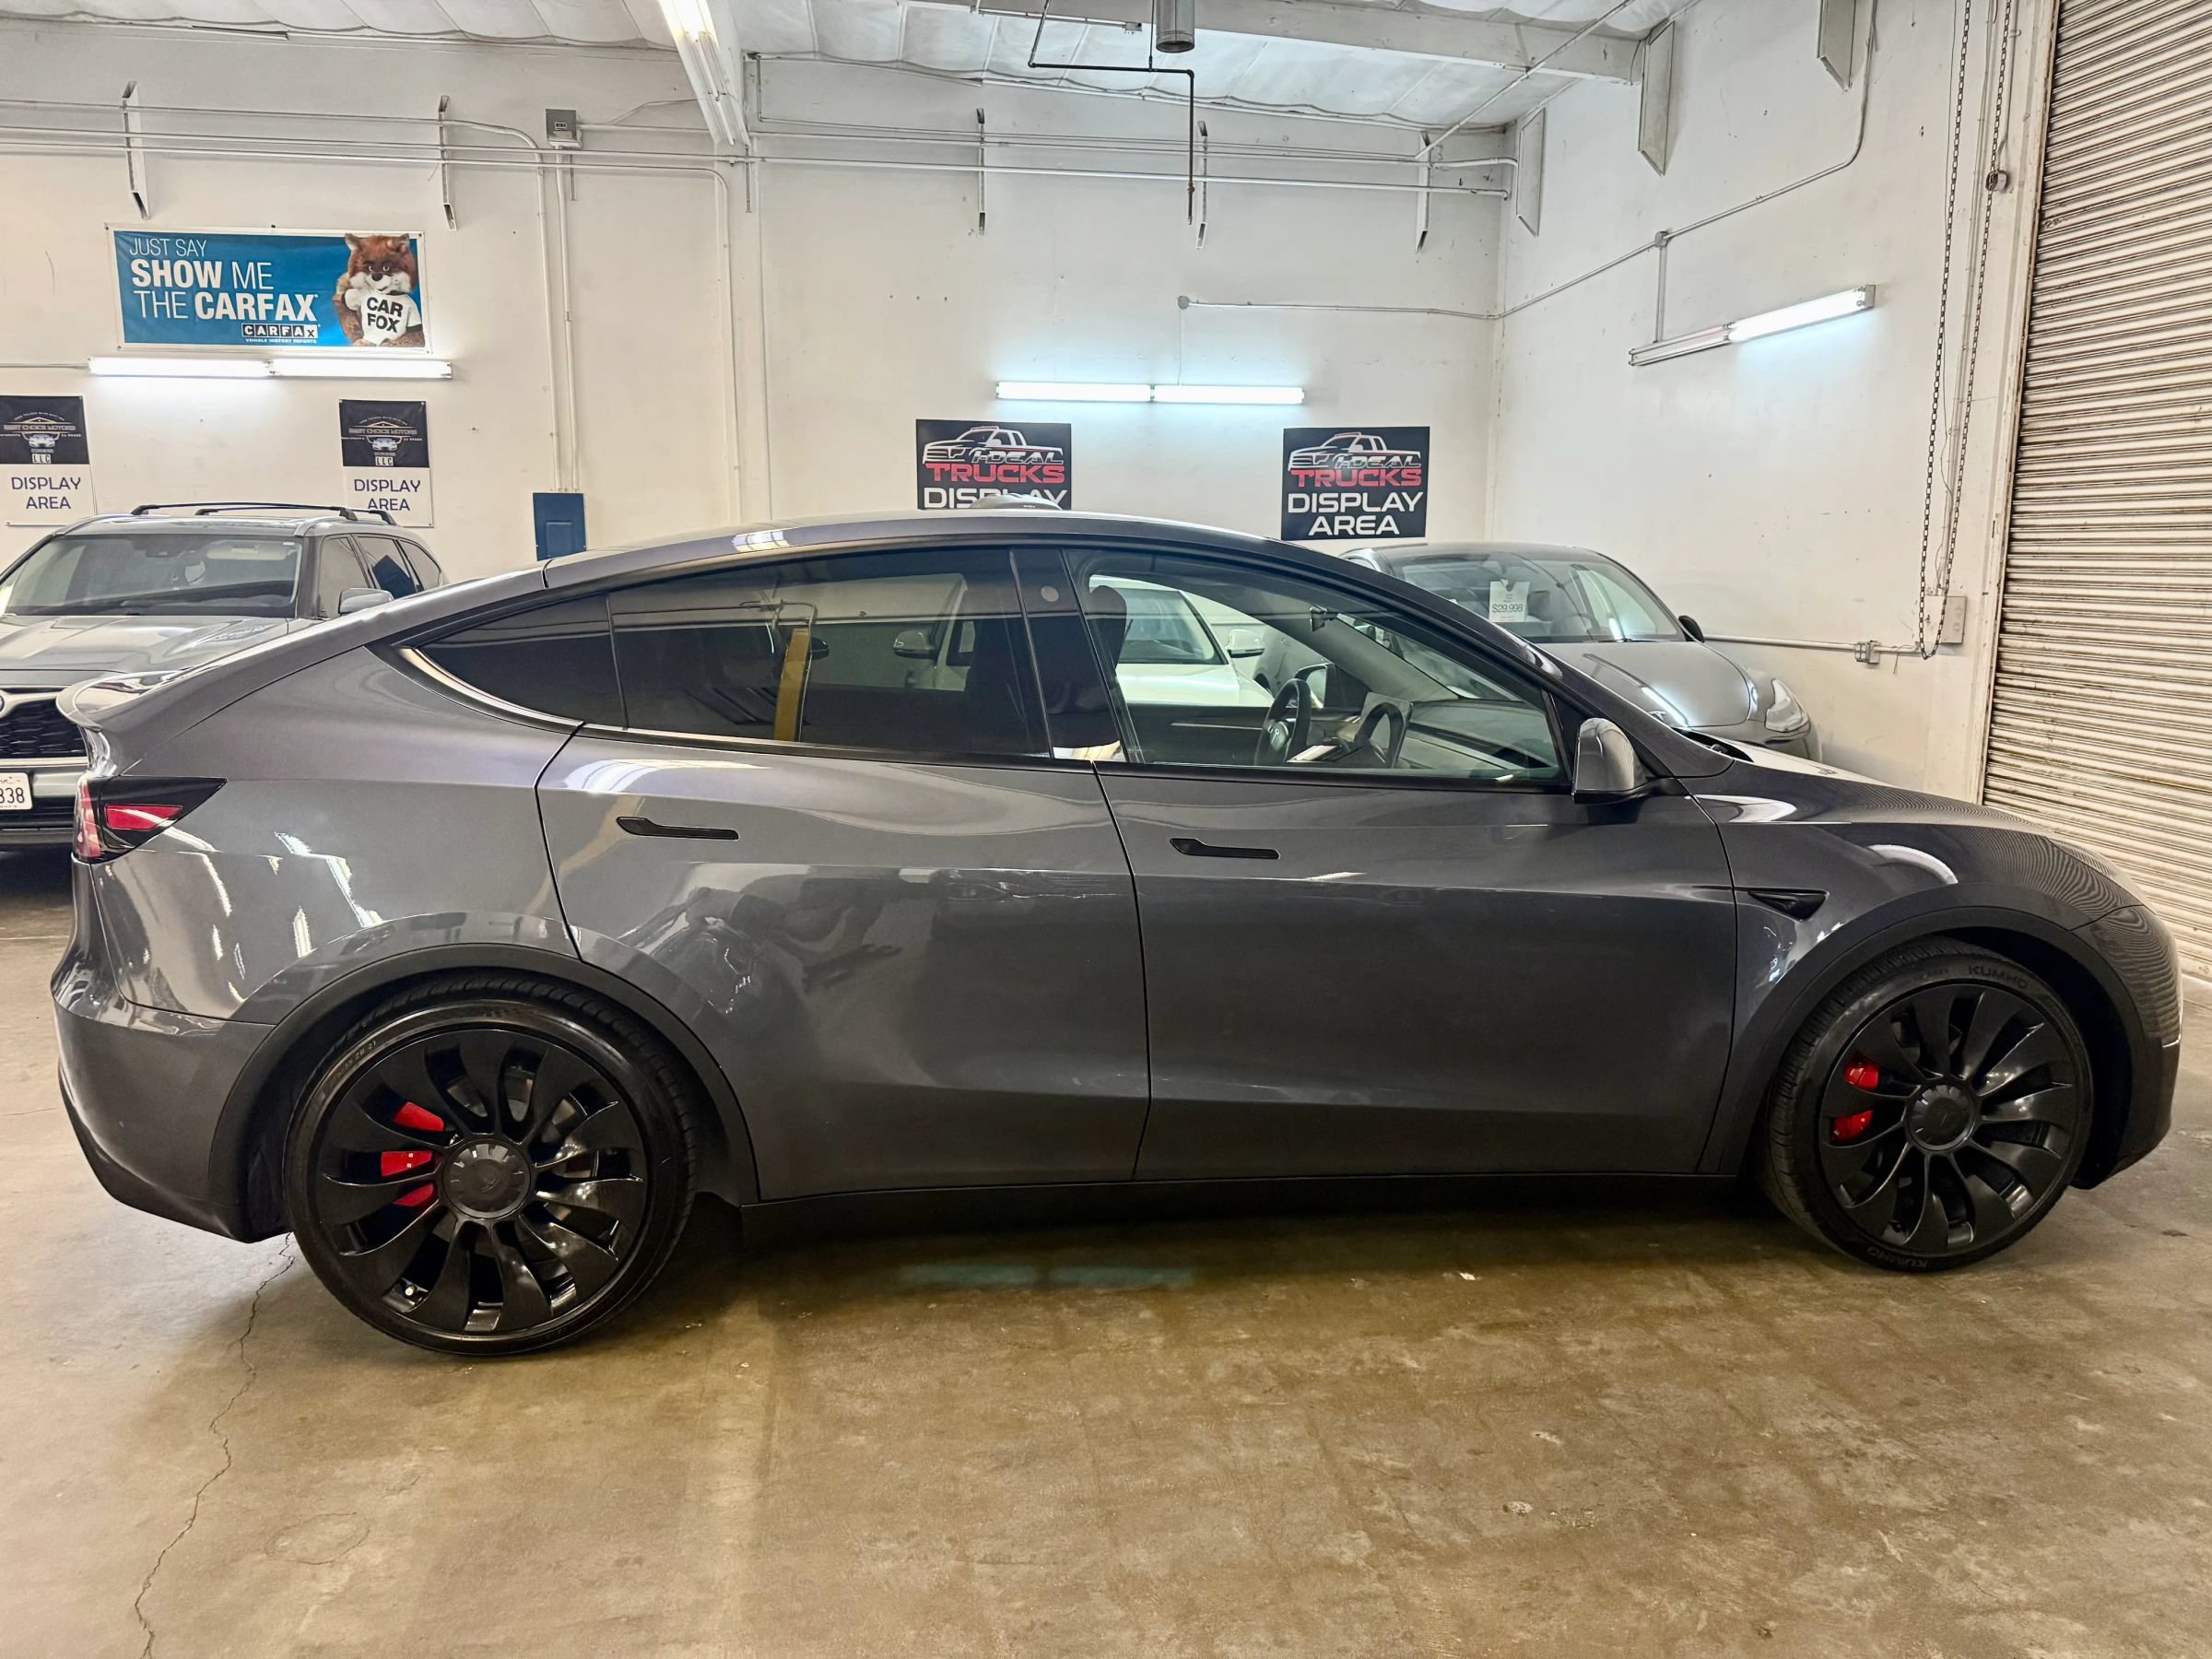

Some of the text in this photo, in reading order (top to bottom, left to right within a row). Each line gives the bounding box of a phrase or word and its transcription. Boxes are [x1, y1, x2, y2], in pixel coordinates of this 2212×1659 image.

[129, 238, 207, 257] JUST SAY
[131, 258, 274, 289] SHOW ME
[133, 290, 317, 322] THE CARFAX
[367, 296, 404, 318] CAR
[242, 324, 318, 338] CARFAX
[367, 312, 400, 333] FOX
[33, 454, 51, 464] LLC
[376, 456, 394, 465] LLC
[11, 477, 81, 490] DISPLAY
[924, 463, 1065, 484] TRUCKS
[1290, 468, 1422, 488] TRUCKS
[354, 478, 421, 493] DISPLAY
[26, 496, 71, 510] AREA
[368, 498, 411, 512] AREA
[924, 487, 1068, 509] DISY
[1288, 491, 1424, 513] DISPLAY
[1308, 514, 1401, 536] AREA
[1968, 965, 2028, 989] KUMHO
